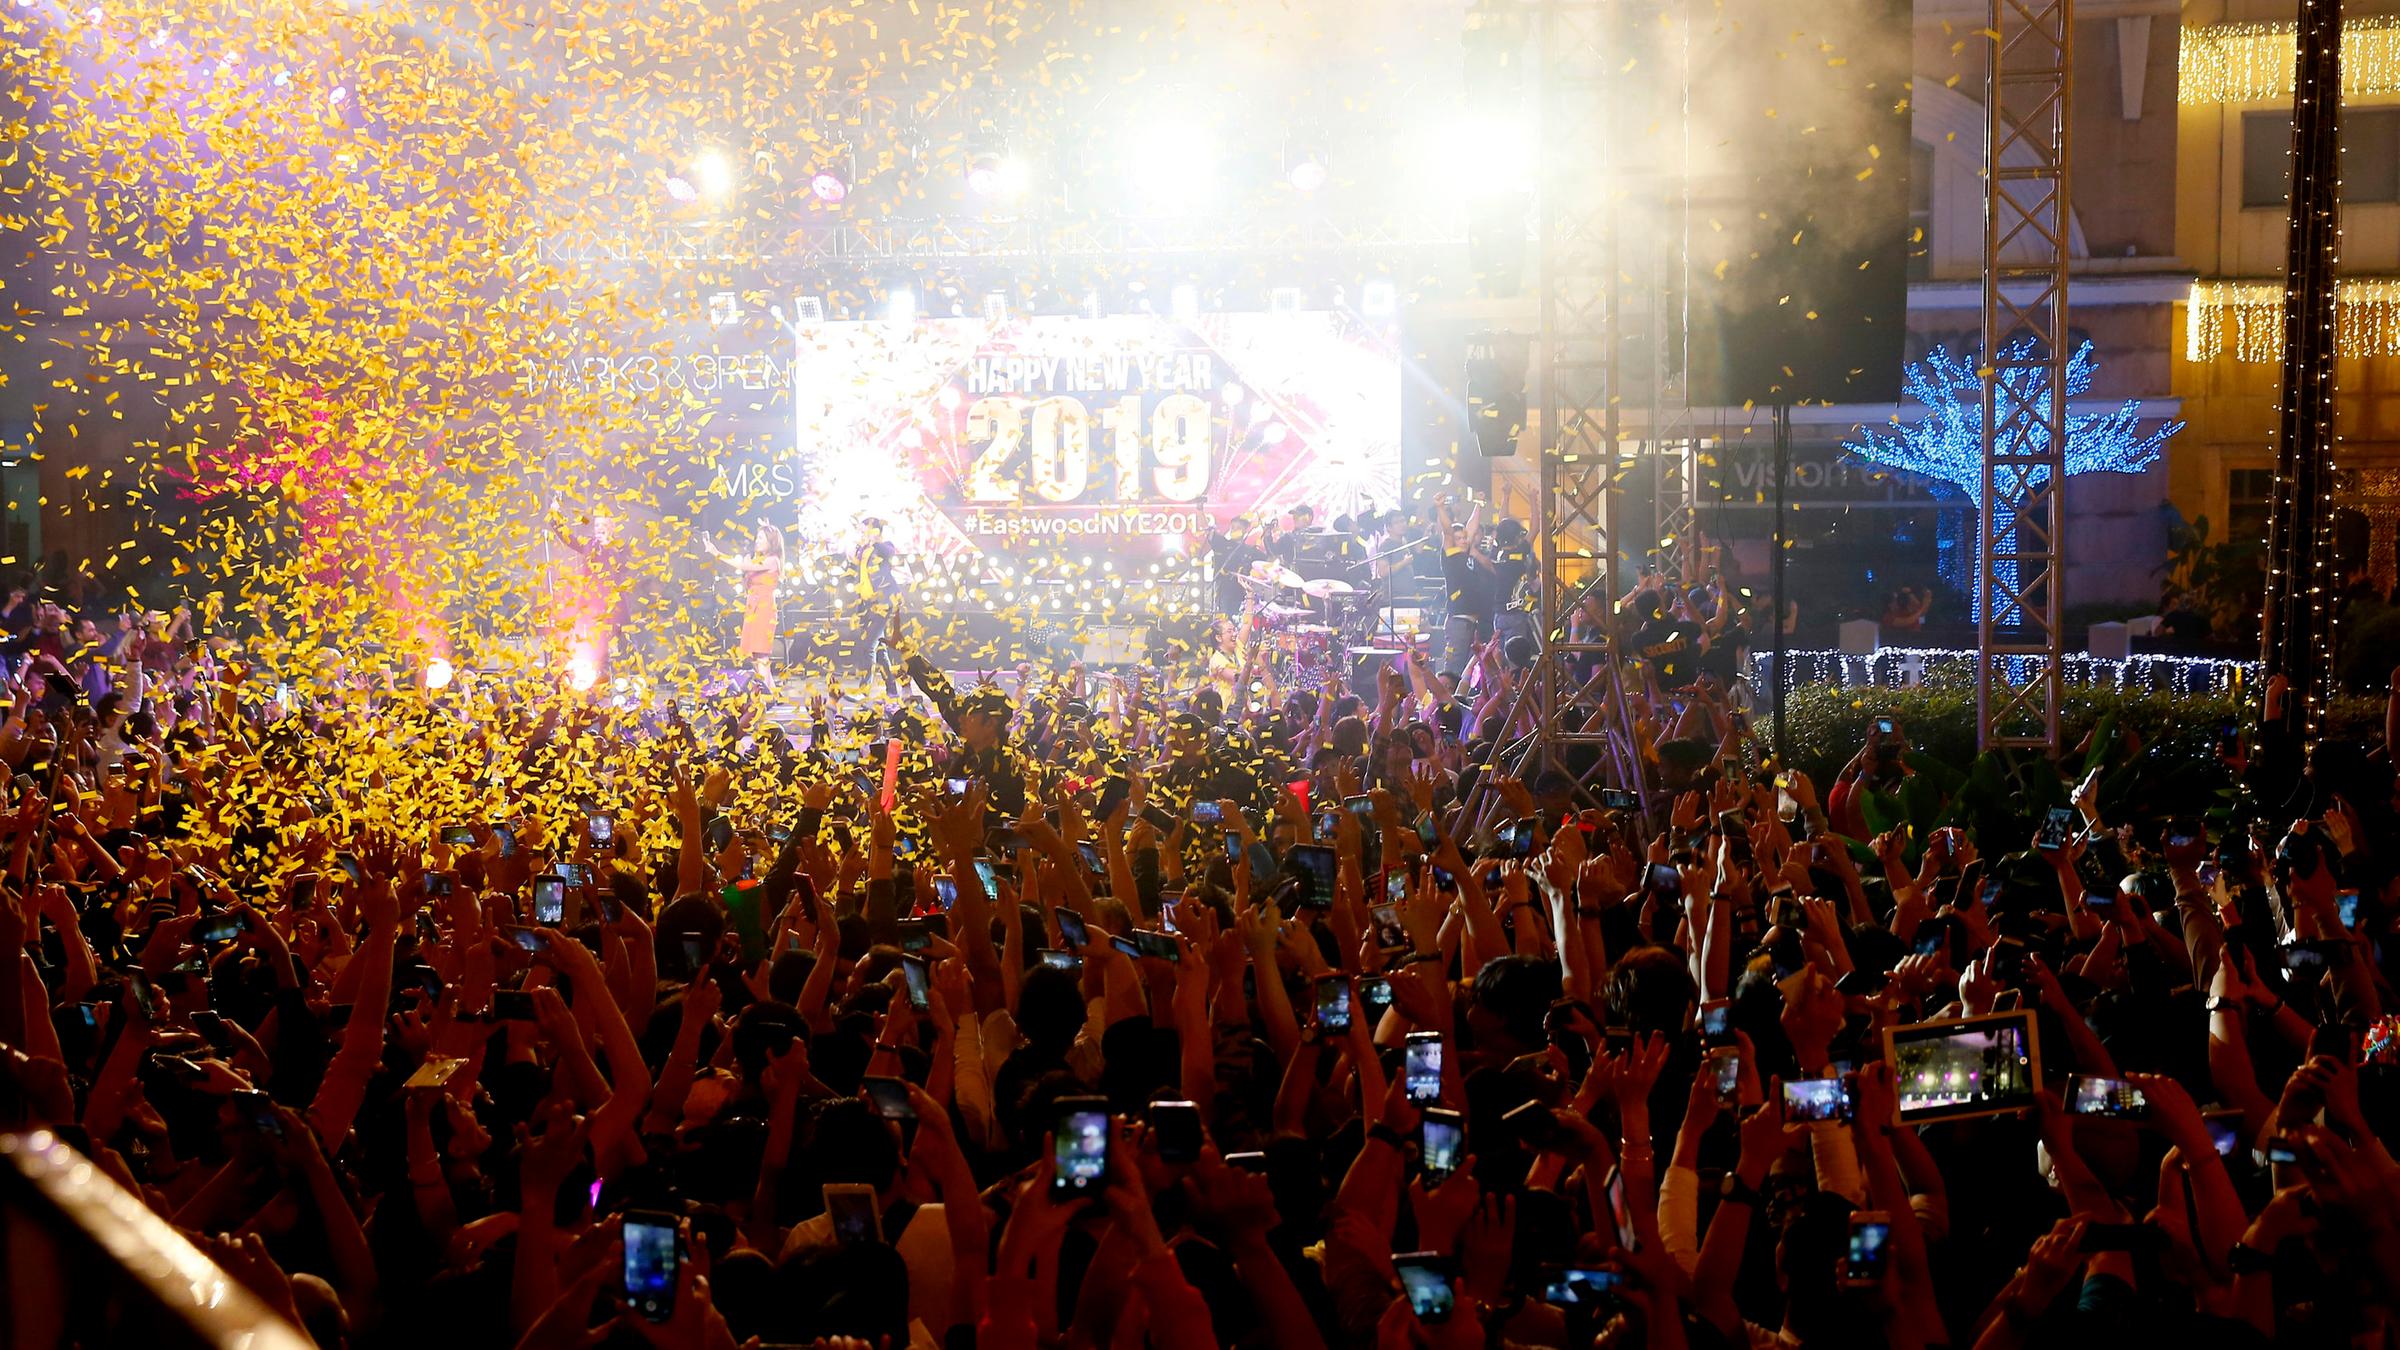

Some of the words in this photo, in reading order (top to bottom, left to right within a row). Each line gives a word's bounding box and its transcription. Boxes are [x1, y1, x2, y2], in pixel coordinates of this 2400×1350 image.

[967, 353, 1060, 393] HAPPY
[1064, 352, 1129, 391] NEW
[1135, 352, 1212, 391] YEAR
[966, 394, 1213, 502] 2019
[718, 463, 795, 497] M&S
[1734, 451, 1847, 488] vision
